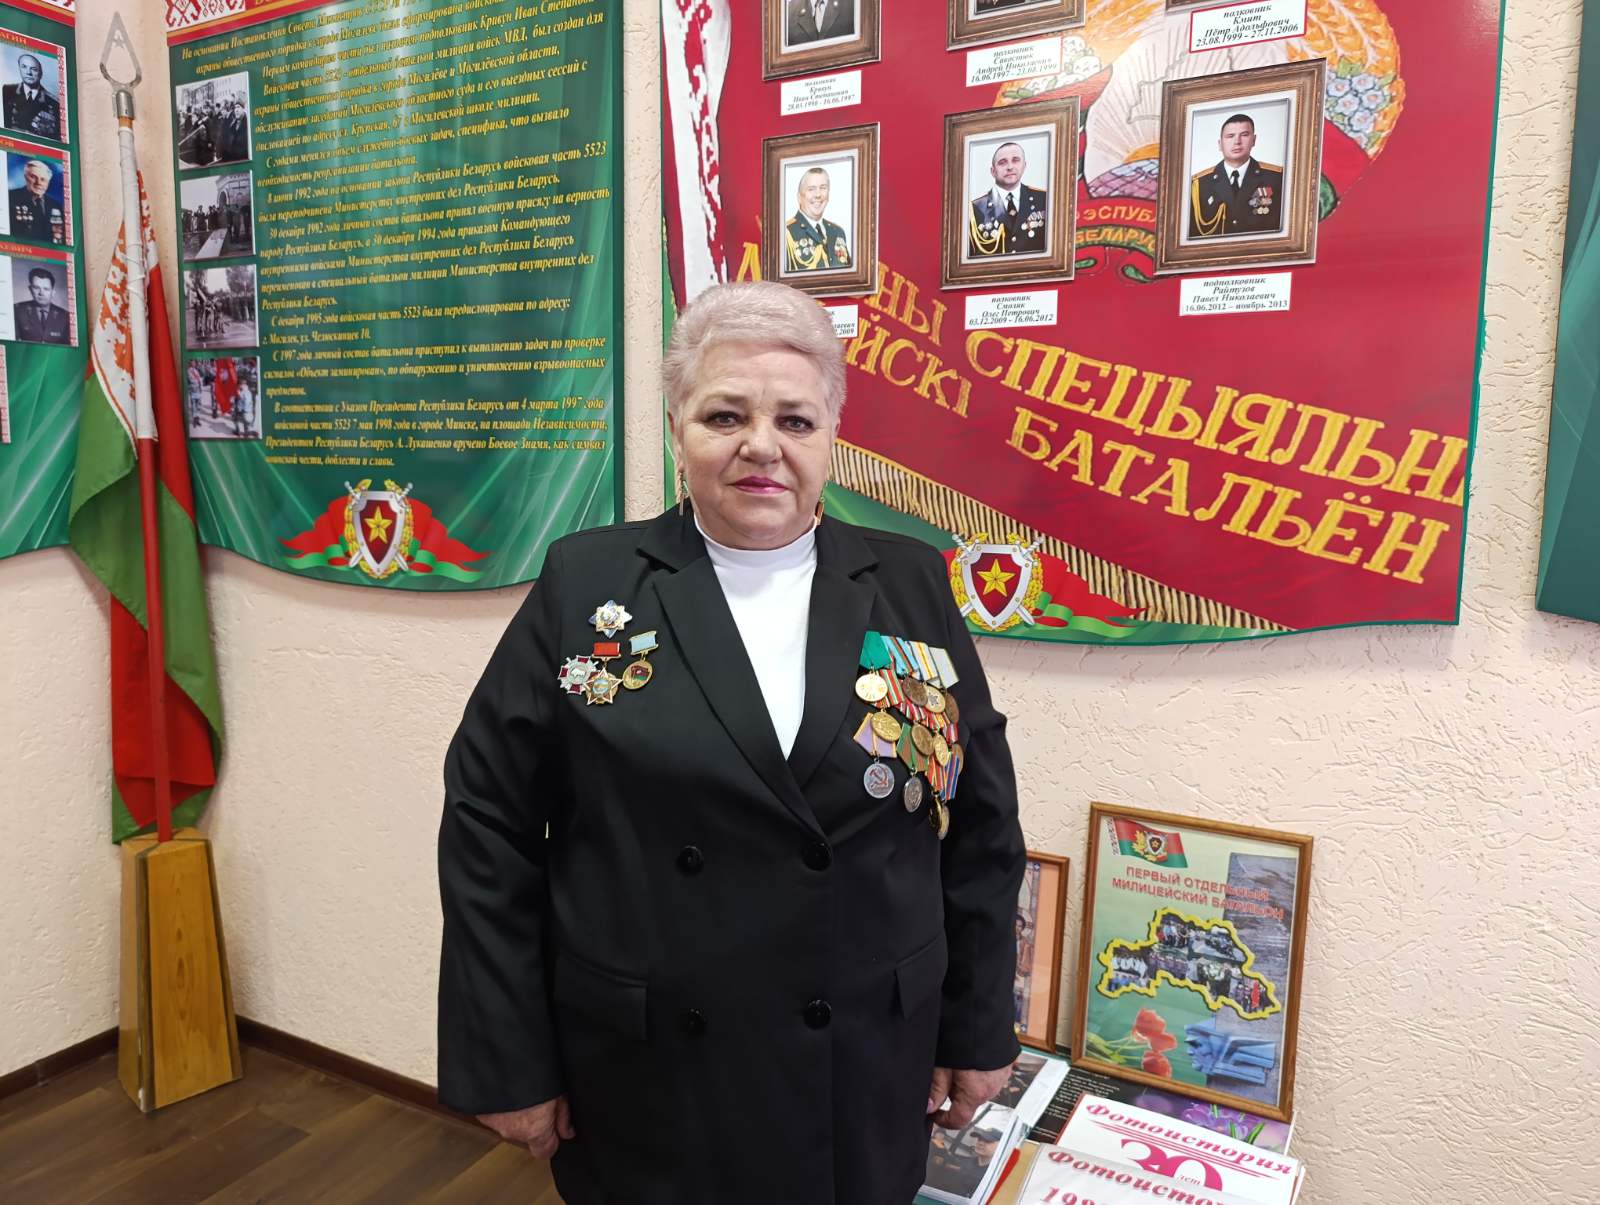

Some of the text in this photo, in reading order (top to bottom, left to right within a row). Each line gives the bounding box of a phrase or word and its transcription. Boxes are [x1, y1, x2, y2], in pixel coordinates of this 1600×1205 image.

[1224, 5, 1271, 18] полковник
[1233, 15, 1261, 25] Кмит
[1196, 24, 1298, 47] 23.08.1999 27.11.2006
[1205, 18, 1289, 38] Пётр Адольфович
[971, 71, 1009, 83] 16.06.1997
[583, 140, 607, 155] 5523
[1076, 206, 1155, 222] ЭСПУБ
[1075, 228, 1155, 251] БЕЛАРУС
[1203, 278, 1266, 287] подполковник
[1222, 293, 1275, 301] Николаевич
[1002, 309, 1040, 317] Петрович
[1186, 300, 1287, 312] 16.06.2012 ноябрь 2013
[969, 314, 1053, 326] 03.12.2009 16.06.2012
[965, 329, 1468, 506] СПЕЦЫЯЛЬН
[1006, 407, 1450, 584] БАТАЛЬЁН
[1126, 866, 1180, 886] ПЕРВЫЙ
[1112, 878, 1207, 906] МИЛИЦЕЙСКИЙ
[1086, 1103, 1292, 1175] Фотоистория
